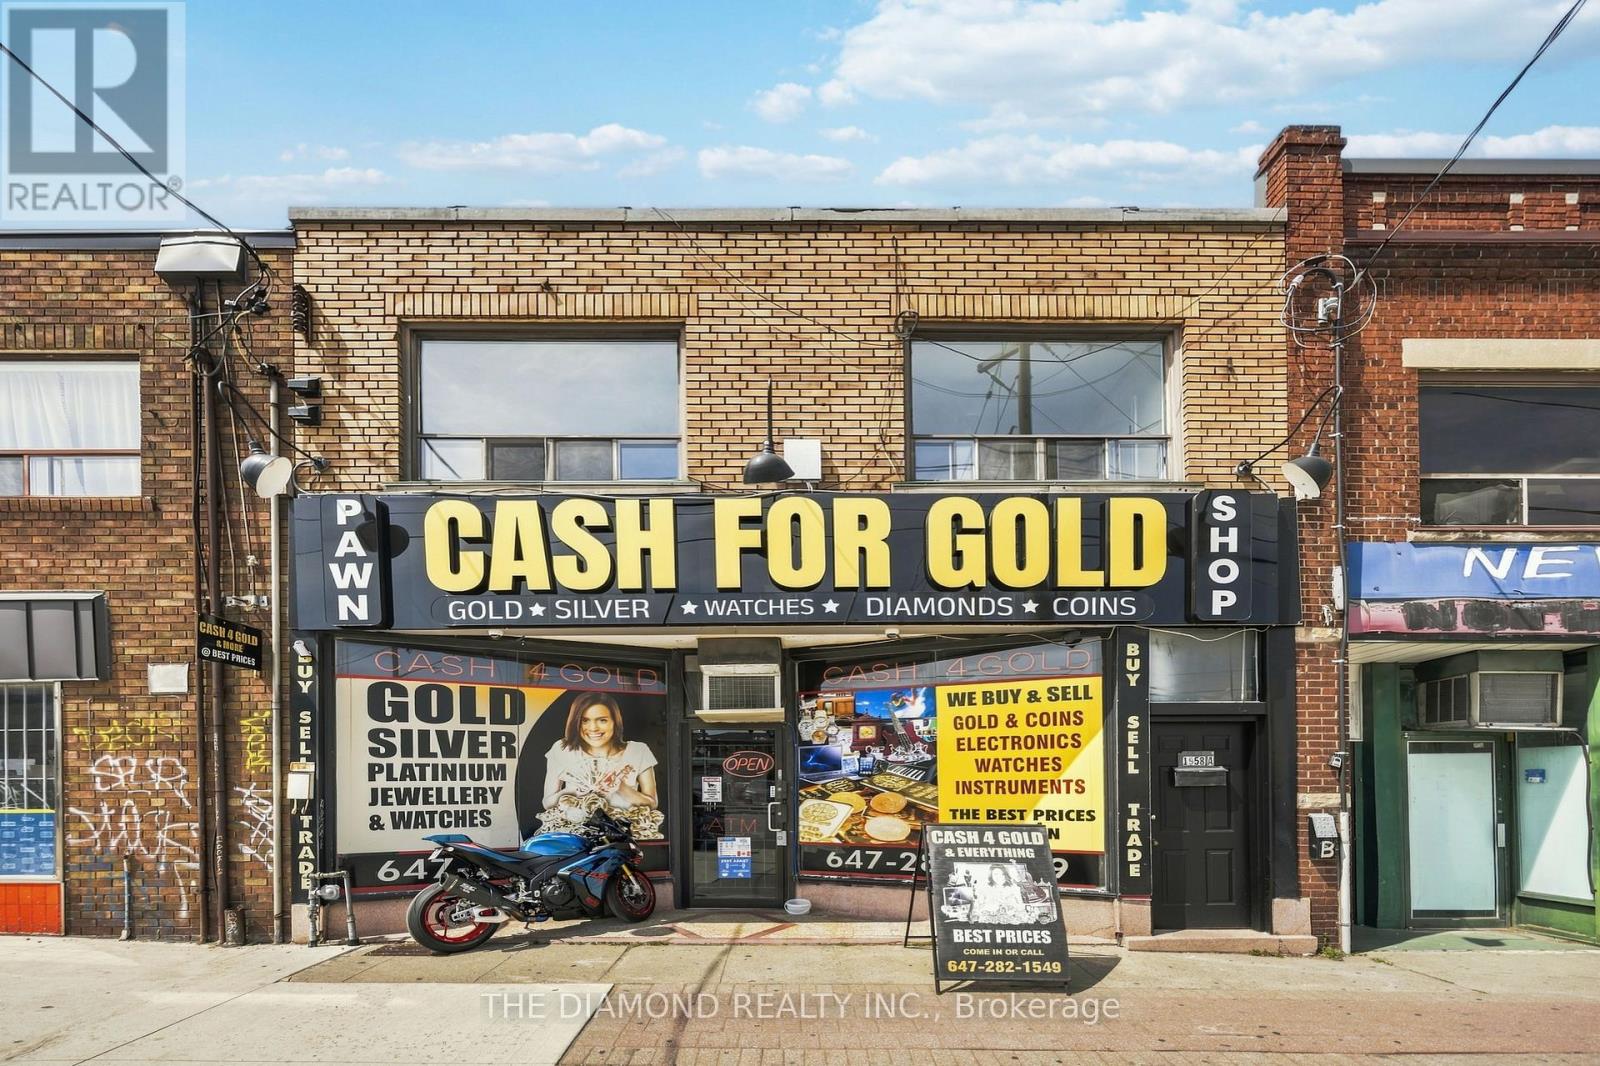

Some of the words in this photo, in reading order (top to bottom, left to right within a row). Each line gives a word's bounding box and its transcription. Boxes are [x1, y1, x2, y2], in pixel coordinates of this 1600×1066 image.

[424, 498, 677, 592] CASH
[714, 496, 892, 591] FOR
[926, 496, 1168, 590] GOLD
[328, 499, 374, 621] PAWN
[1207, 495, 1240, 616] SHOP
[1463, 545, 1600, 579] NE
[448, 600, 522, 620] GOLD
[555, 599, 650, 619] SILVER
[704, 598, 814, 617] WATCHES
[866, 596, 1013, 617] DIAMONDS
[1052, 596, 1137, 617] COINS
[200, 622, 225, 638] CASH
[227, 629, 233, 640] 4
[235, 631, 258, 646] GOLD
[212, 649, 230, 661] BEST
[231, 653, 256, 665] PRICES
[822, 662, 918, 685] CASH
[978, 650, 1092, 675] GOLD
[1126, 643, 1140, 687] BUY
[373, 650, 496, 678] CASH
[559, 663, 658, 687] GOLD
[367, 681, 527, 725] GOLD
[946, 691, 979, 708] WE
[981, 689, 1023, 706] BUY
[1027, 688, 1042, 704] &
[1046, 684, 1093, 703] SELL
[953, 714, 999, 731] GOLD
[1005, 713, 1019, 729] &
[1025, 710, 1085, 728] COINS
[298, 710, 312, 763] SEL
[368, 728, 518, 759] SILVER
[956, 732, 1083, 752] ELECTRONICS
[1126, 715, 1141, 775] SELL
[368, 762, 507, 783] PLATINIUM
[725, 757, 770, 771] OPEN
[974, 756, 1063, 773] WATCHES
[368, 786, 504, 807] JEWELLERY
[955, 778, 1086, 796] INSTRUMENTS
[369, 813, 385, 831] &
[390, 809, 492, 830] WATCHES
[707, 815, 757, 833] ATM
[949, 808, 980, 821] THE
[988, 808, 1027, 821] BEST
[1033, 808, 1097, 822] PRICES
[931, 830, 979, 845] CASH
[983, 830, 996, 845] 4
[998, 831, 1045, 846] GOLD
[1126, 803, 1143, 878] TRADE
[945, 848, 956, 858] &
[958, 847, 1036, 859] EVERYTHING
[1320, 840, 1335, 859] B
[953, 928, 993, 944] BEST
[995, 929, 1053, 945] PRICES
[963, 948, 990, 956] COME
[992, 948, 1003, 956] IN
[1005, 948, 1018, 956] OR
[1020, 948, 1045, 956] CALL
[947, 960, 1062, 974] 647-282-1549
